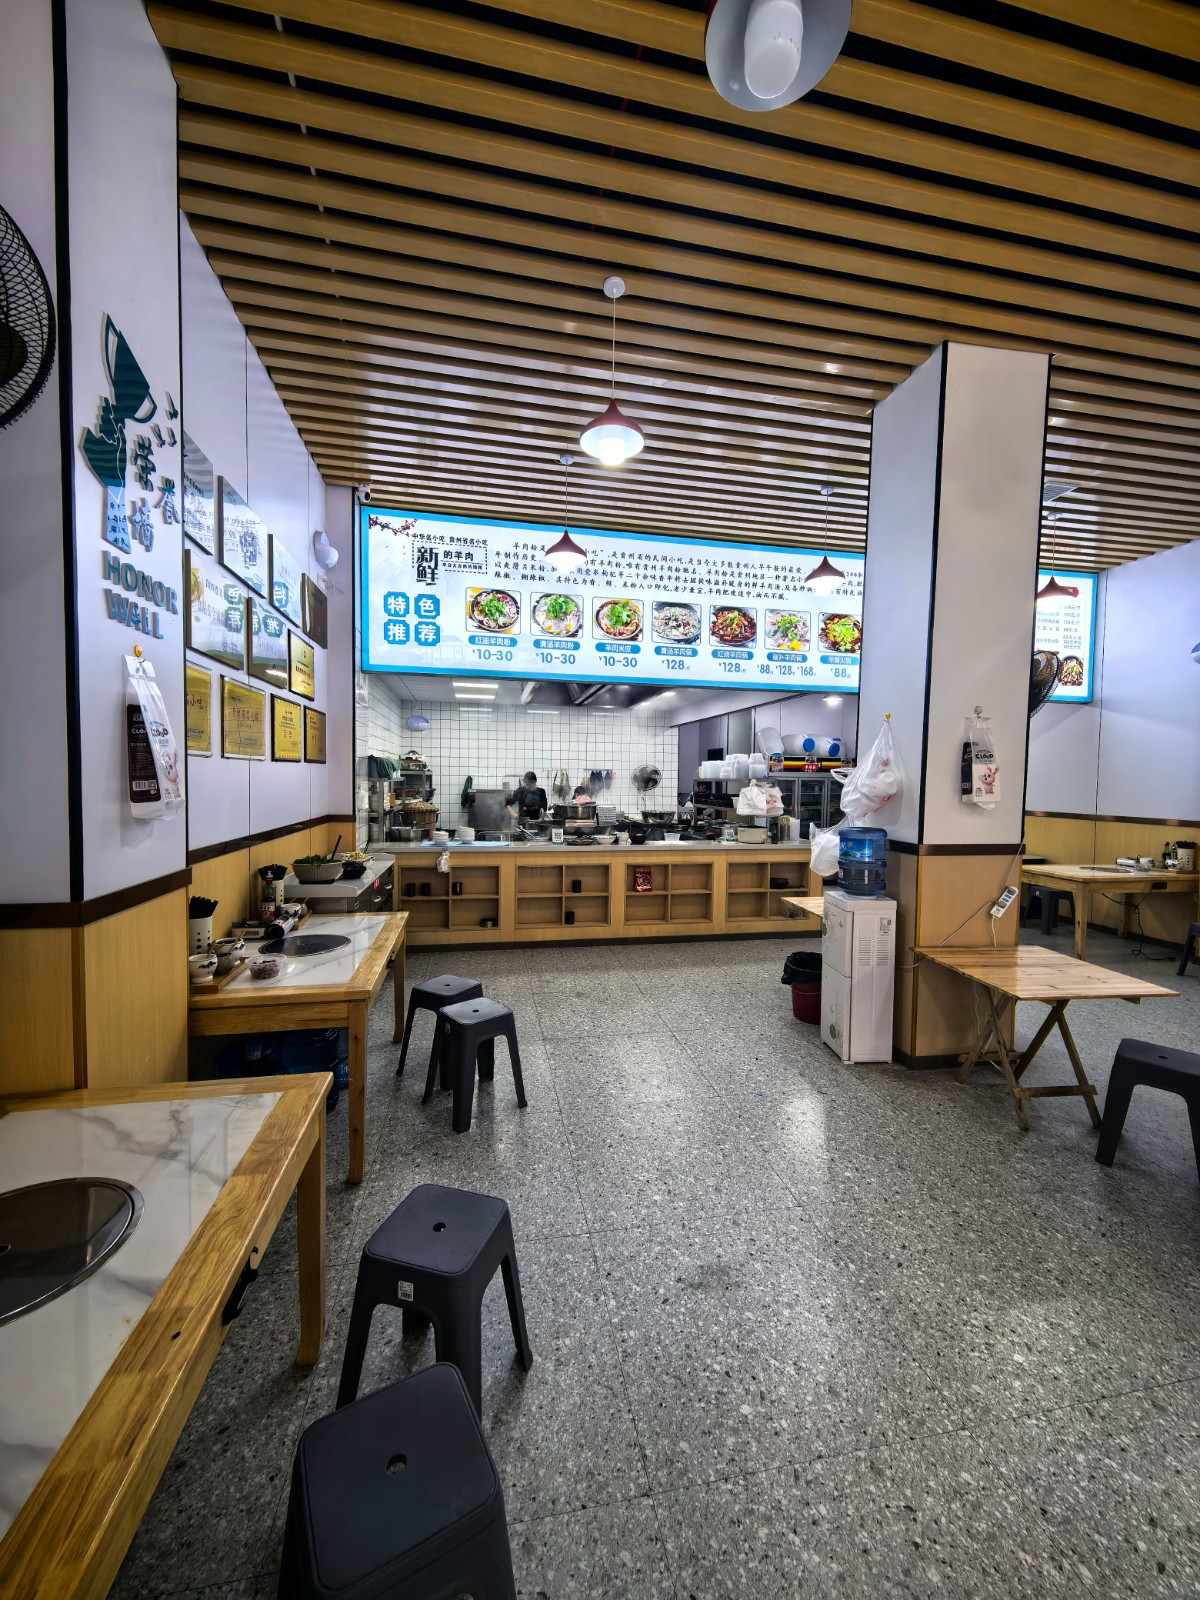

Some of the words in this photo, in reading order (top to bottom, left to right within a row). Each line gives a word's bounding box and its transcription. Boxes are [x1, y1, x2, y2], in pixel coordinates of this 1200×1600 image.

[411, 533, 445, 542] 中华名小吃
[449, 536, 488, 546] 贵州省名小吃
[444, 549, 474, 561] 的羊肉
[416, 546, 439, 586] 新鲜
[103, 550, 178, 615] HONOR
[105, 588, 164, 640] WALL
[387, 595, 437, 616] 特色
[387, 622, 437, 643] 推荐
[475, 636, 511, 647] 红油羊肉粉
[539, 640, 575, 650] 清汤羊肉粉
[604, 643, 632, 653] 羊肉米皮
